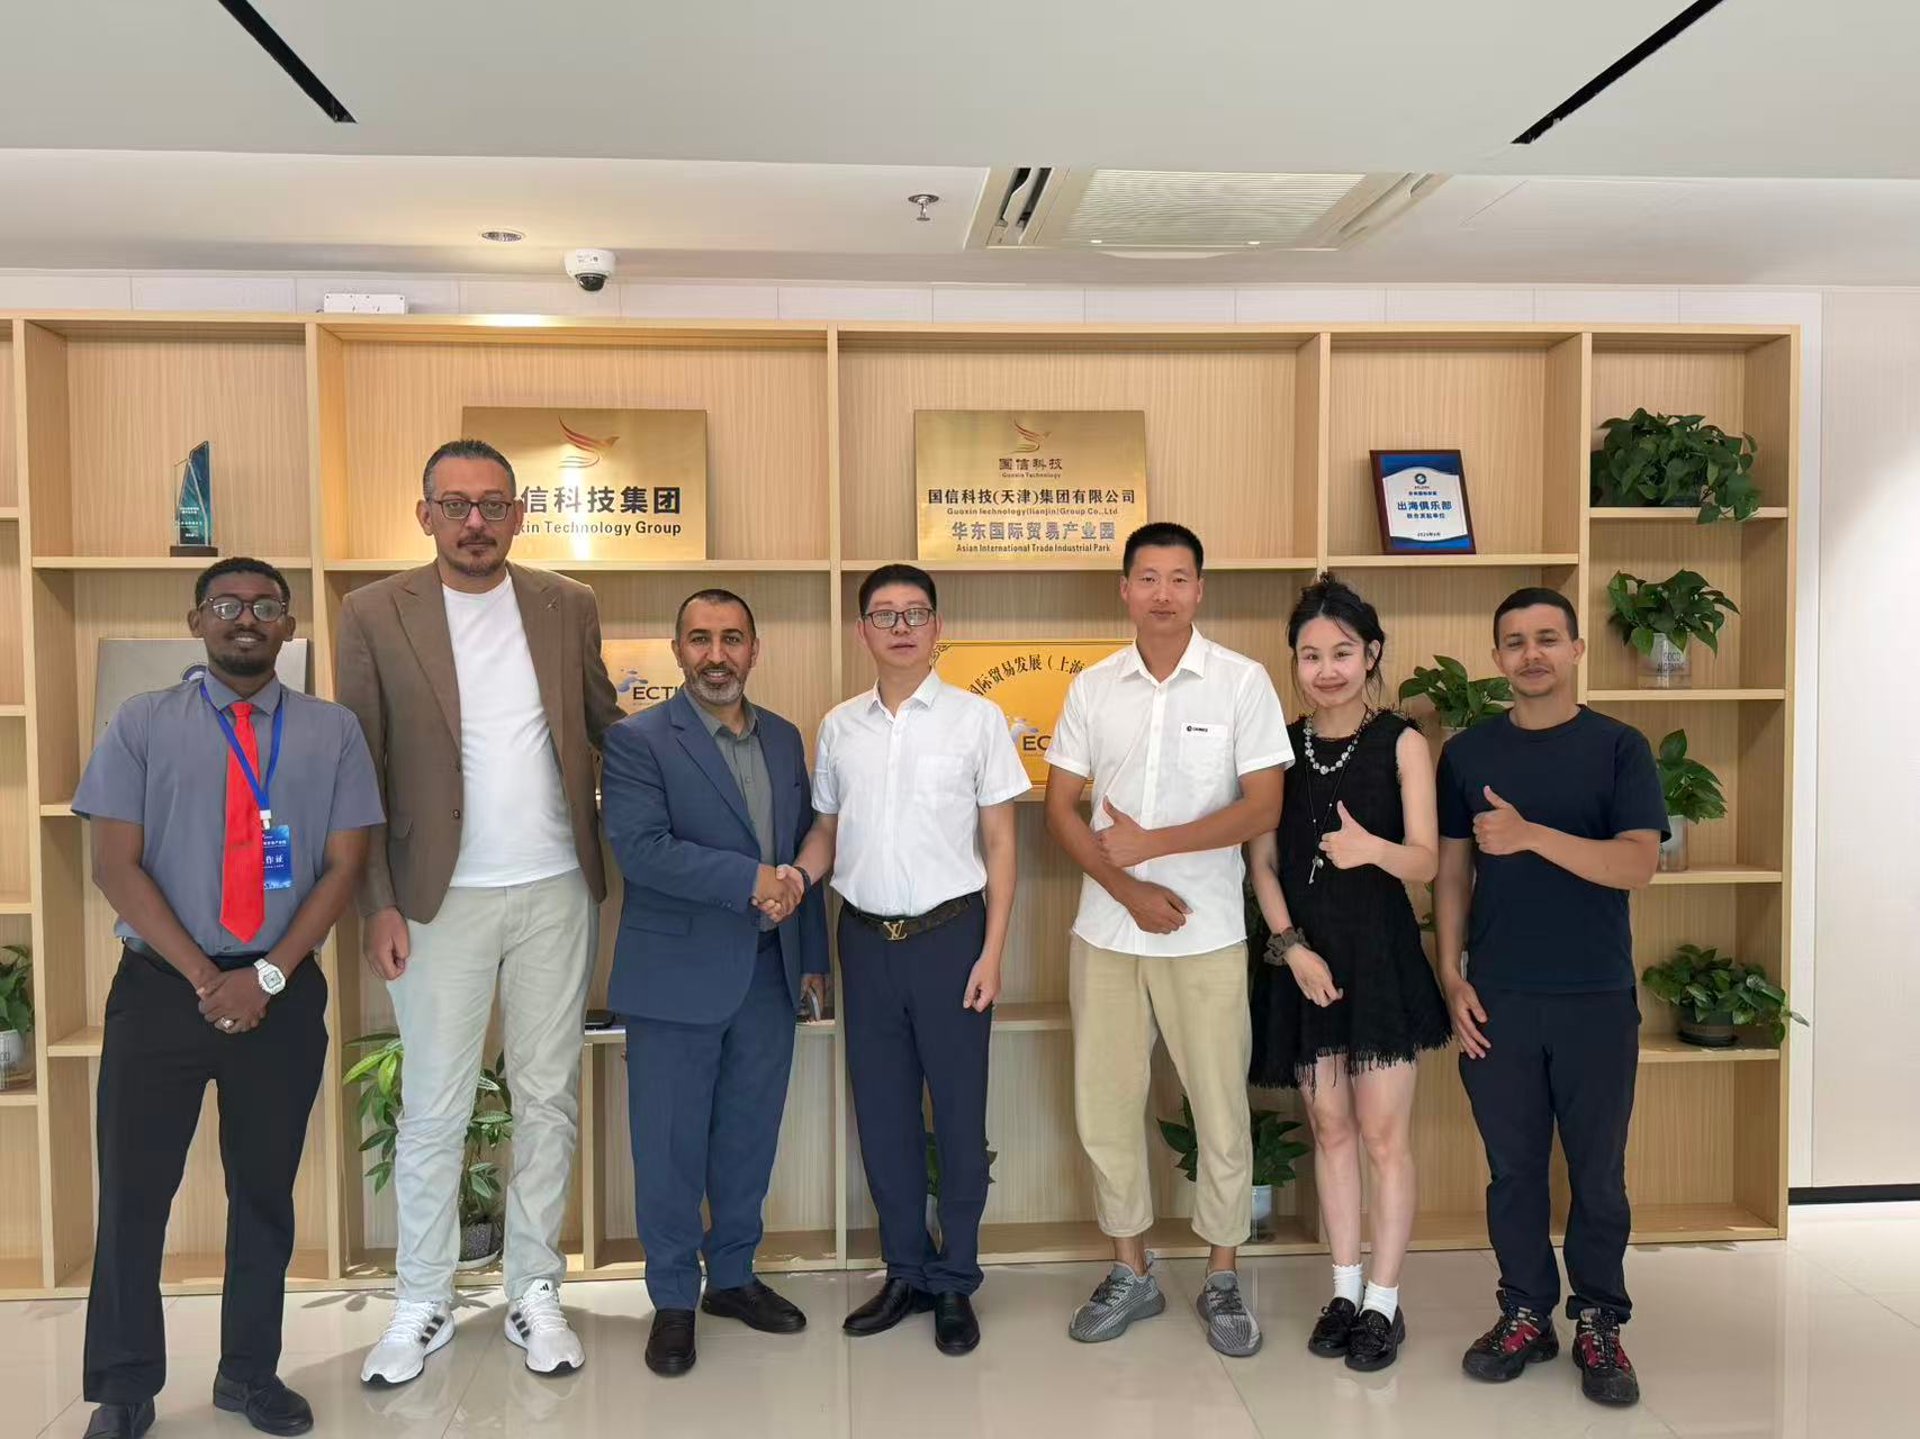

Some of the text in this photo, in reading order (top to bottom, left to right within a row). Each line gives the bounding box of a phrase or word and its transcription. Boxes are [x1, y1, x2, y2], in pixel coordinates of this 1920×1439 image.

[521, 486, 681, 514] 信科技集团
[544, 521, 631, 536] Technology
[635, 521, 682, 536] Group
[956, 543, 1111, 552] Asian International Trade Industrial Park
